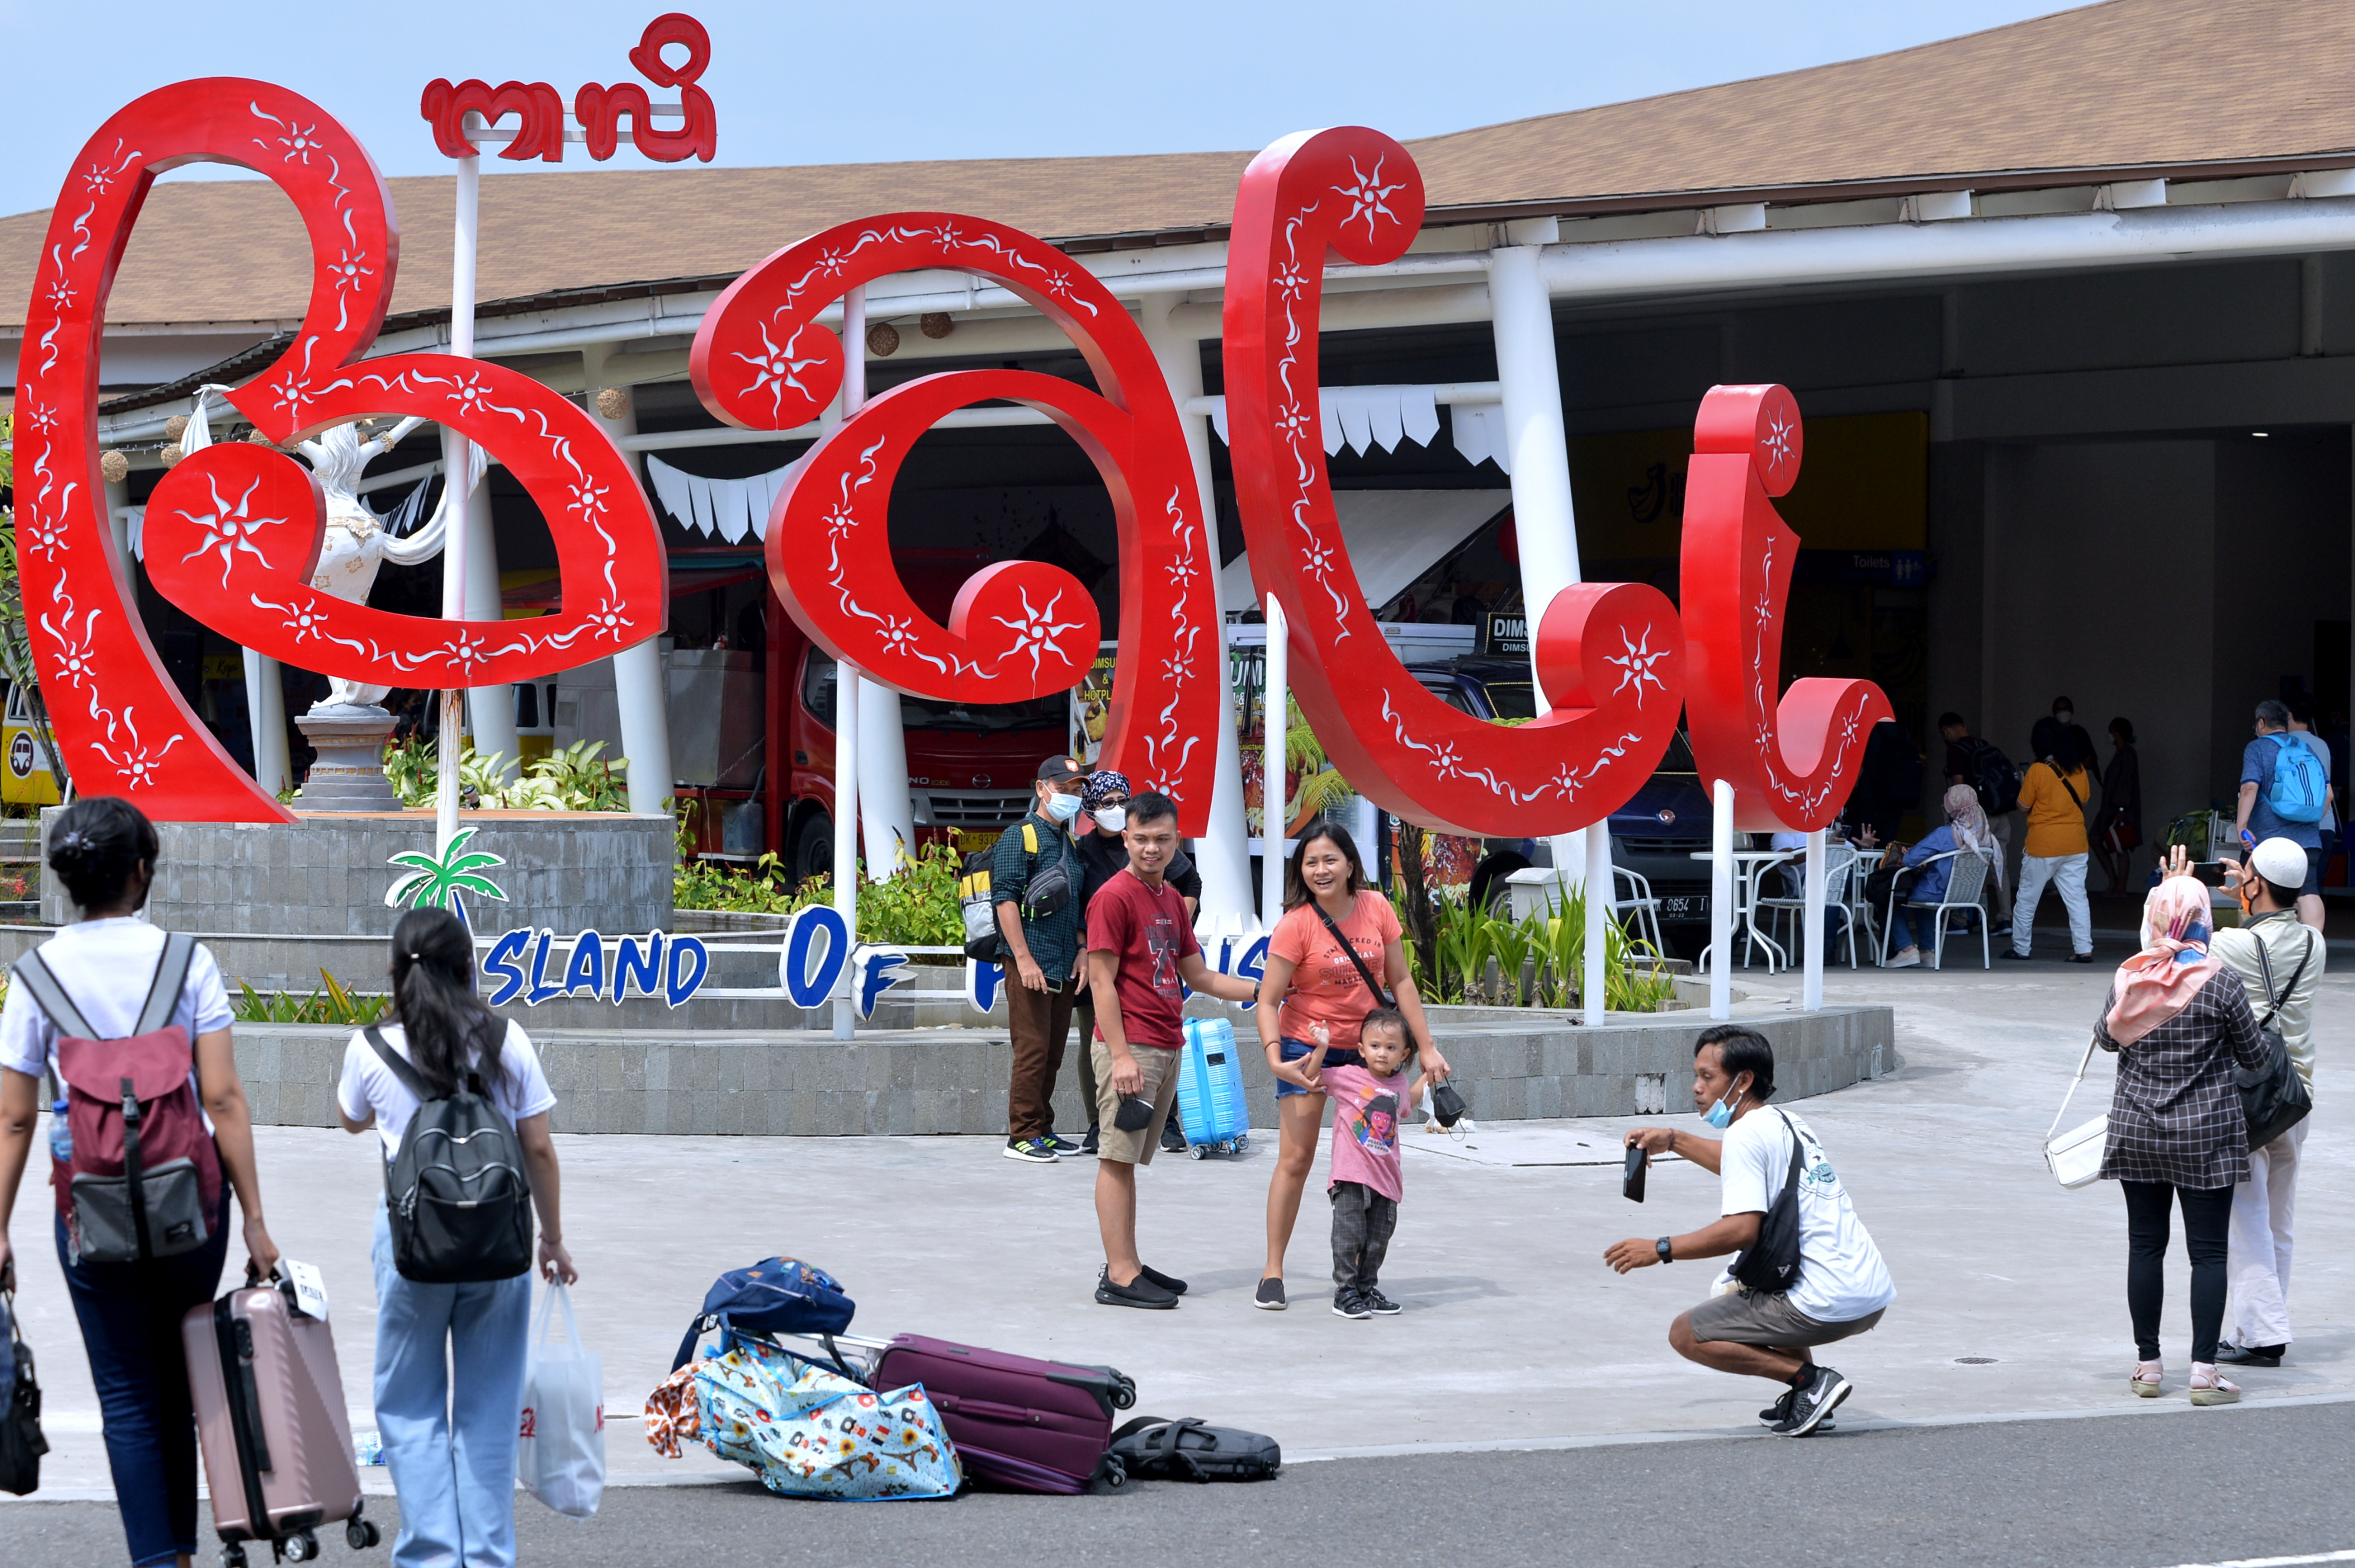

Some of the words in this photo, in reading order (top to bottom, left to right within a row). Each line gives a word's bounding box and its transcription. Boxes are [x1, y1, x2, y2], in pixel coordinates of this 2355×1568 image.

[1853, 555, 1890, 568] Toilets
[1090, 657, 1117, 669] IMSU
[1102, 673, 1109, 685] &
[1667, 898, 1689, 911] 8654
[1324, 945, 1338, 959] STAY
[1334, 951, 1374, 964] ORIGNAL
[779, 903, 910, 1022] OF
[1335, 974, 1372, 984] MAGAZ
